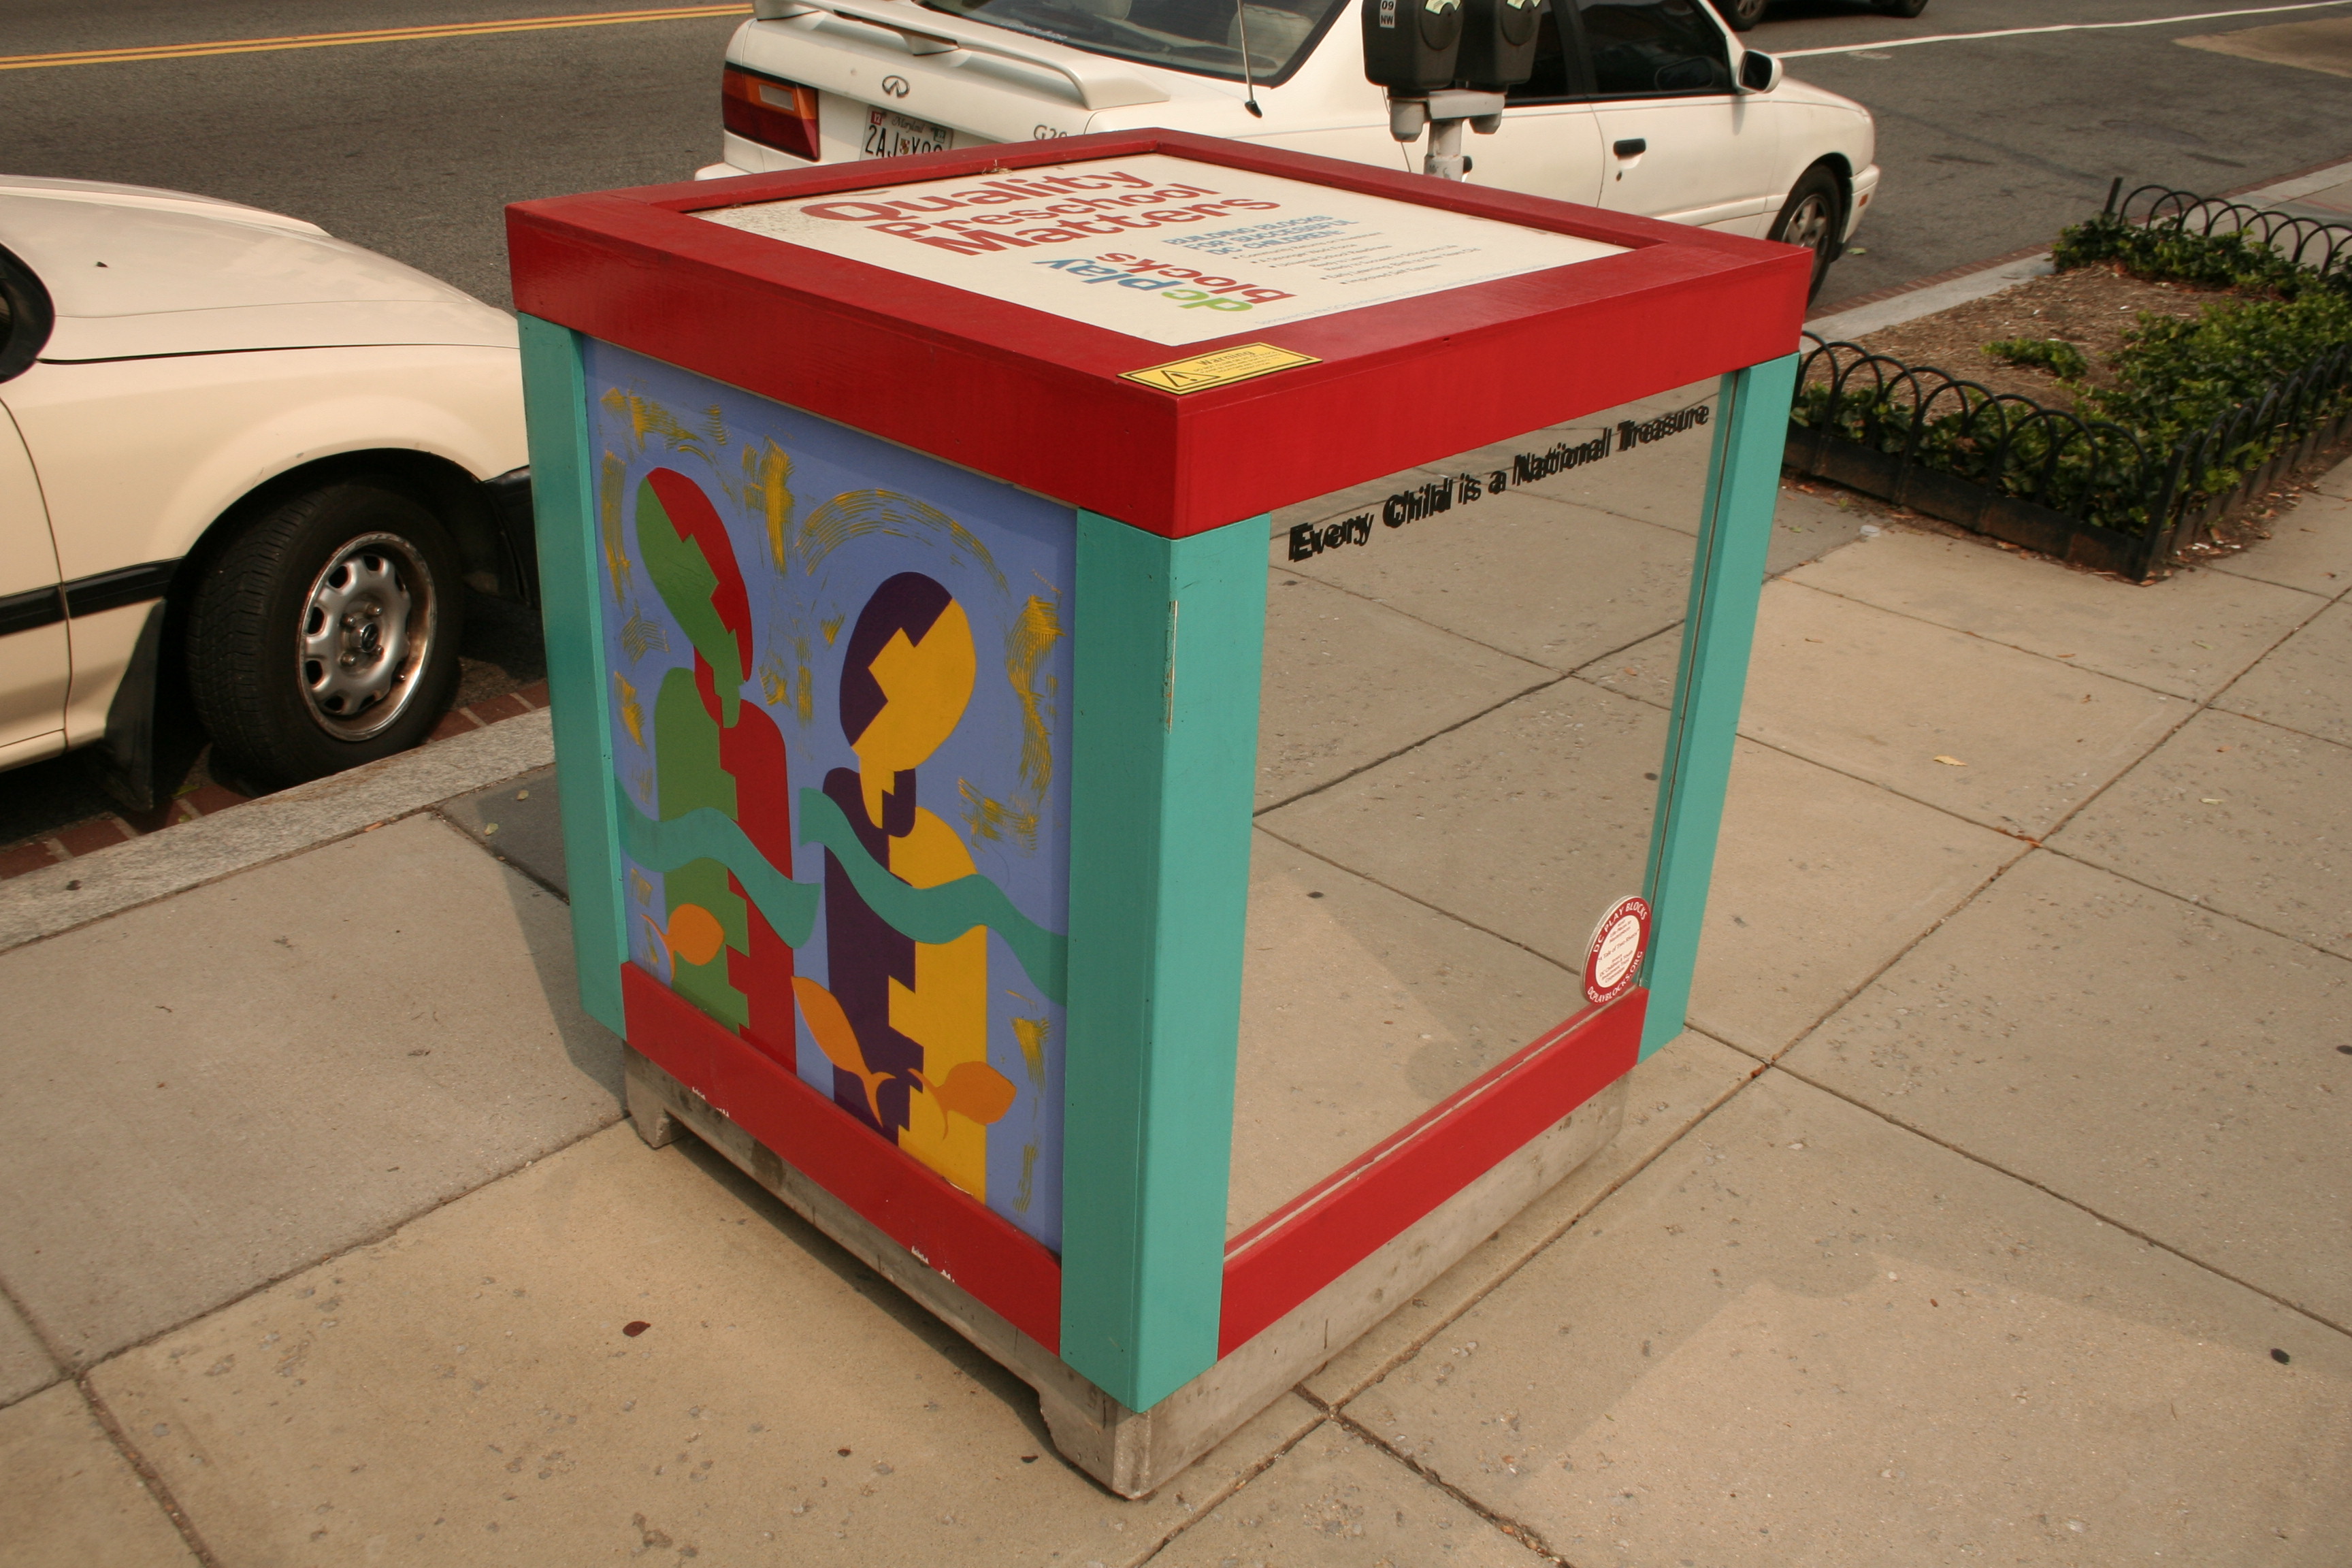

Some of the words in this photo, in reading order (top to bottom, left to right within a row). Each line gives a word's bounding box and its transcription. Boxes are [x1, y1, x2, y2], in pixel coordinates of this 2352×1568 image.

[1381, 15, 1393, 24] NW
[1382, 1, 1394, 10] 09
[874, 113, 881, 122] 12
[800, 172, 1154, 223] Quality
[866, 183, 1220, 240] Preschool
[919, 199, 1280, 256] Matters
[1162, 228, 1256, 245] BUILDING
[1254, 215, 1333, 230] BLOCKS
[1183, 240, 1232, 250] FOR
[1229, 219, 1359, 242] SUCCESSFUL
[1205, 247, 1243, 255] DC
[1032, 259, 1185, 291] play
[1096, 252, 1297, 304] blocks
[1161, 289, 1253, 312] dc
[1196, 351, 1256, 365] Warning
[1288, 513, 1374, 562] Every
[1382, 478, 1453, 528] Child
[1458, 473, 1482, 504] is
[1488, 471, 1507, 495] a
[1512, 427, 1612, 486] National
[1616, 406, 1709, 452] Treasure
[1593, 935, 1604, 953] DC
[1604, 906, 1624, 932] PLAY
[1625, 902, 1648, 920] BLOCKS
[1587, 951, 1643, 1002] DCPLAYBLOCKS.ORG
